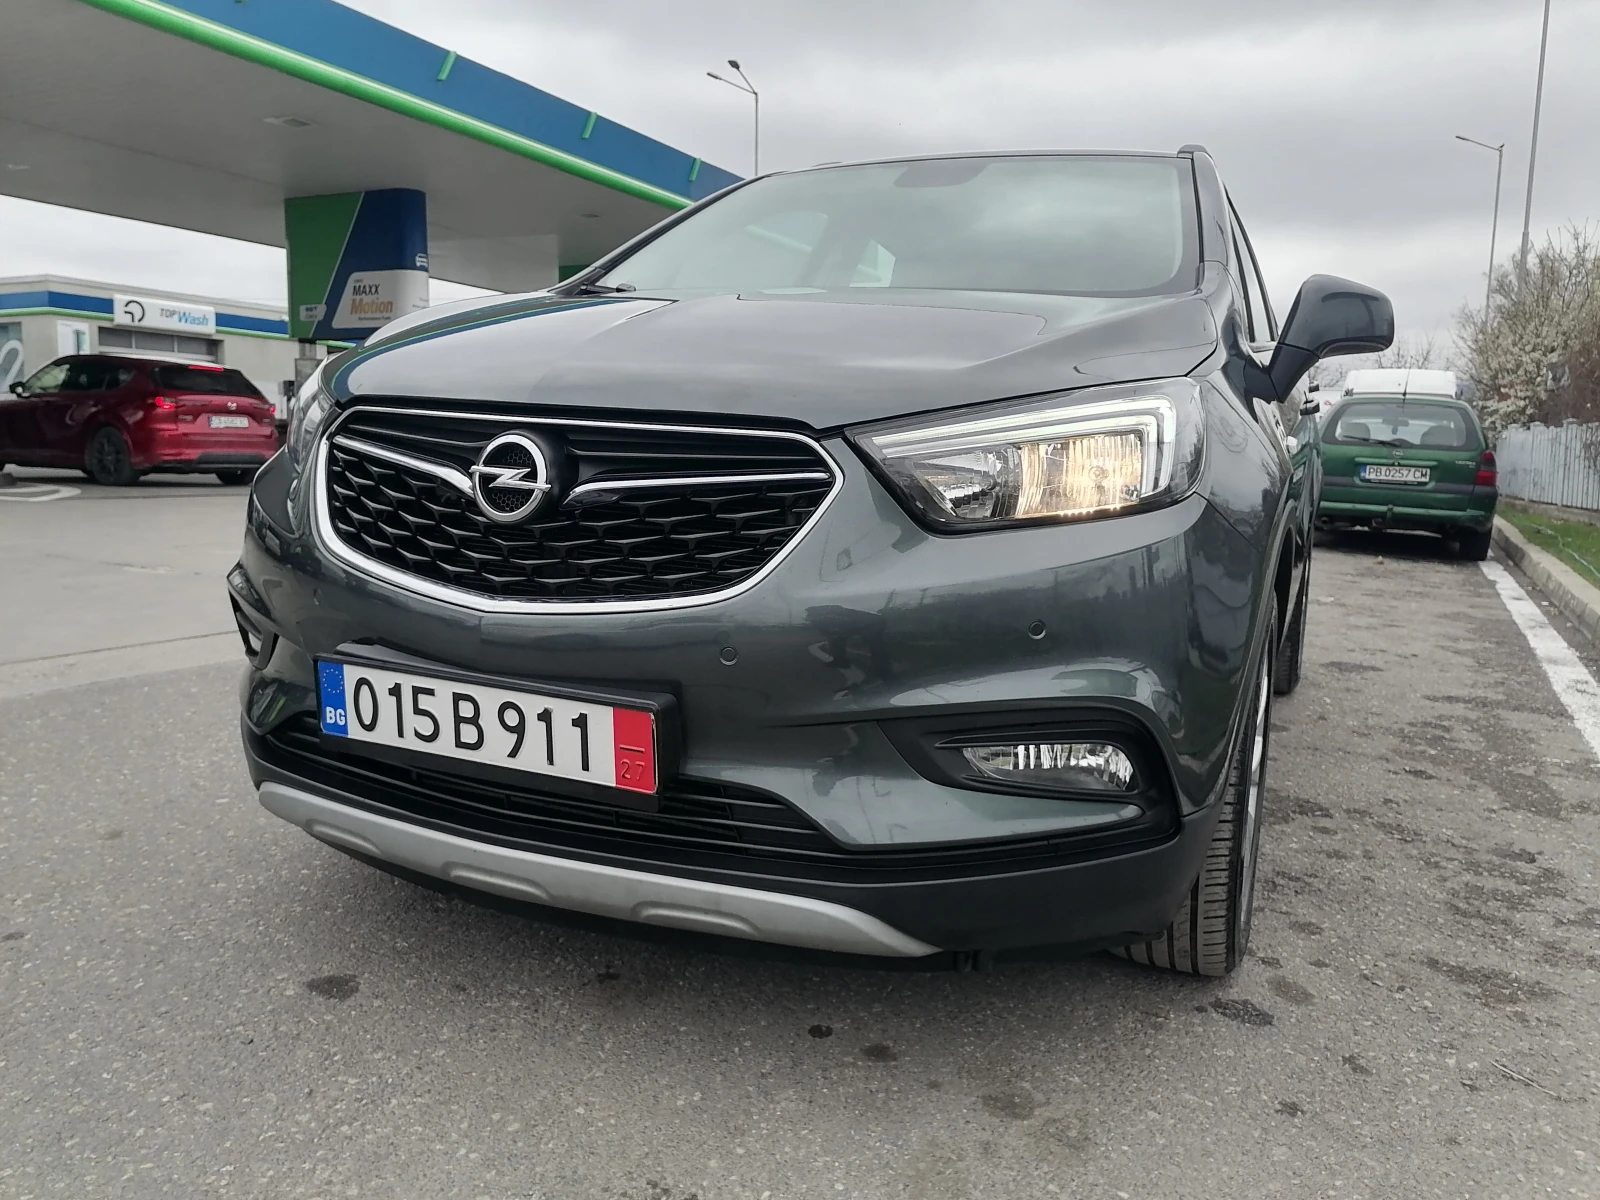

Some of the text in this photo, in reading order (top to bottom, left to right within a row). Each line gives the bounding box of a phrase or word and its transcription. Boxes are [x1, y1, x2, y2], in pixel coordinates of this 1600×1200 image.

[352, 284, 380, 296] MAXX
[350, 298, 393, 315] Motion
[1368, 467, 1428, 479] PB 0257 CM
[326, 706, 346, 726] BG
[353, 676, 590, 772] 015B911
[621, 759, 645, 781] 27
